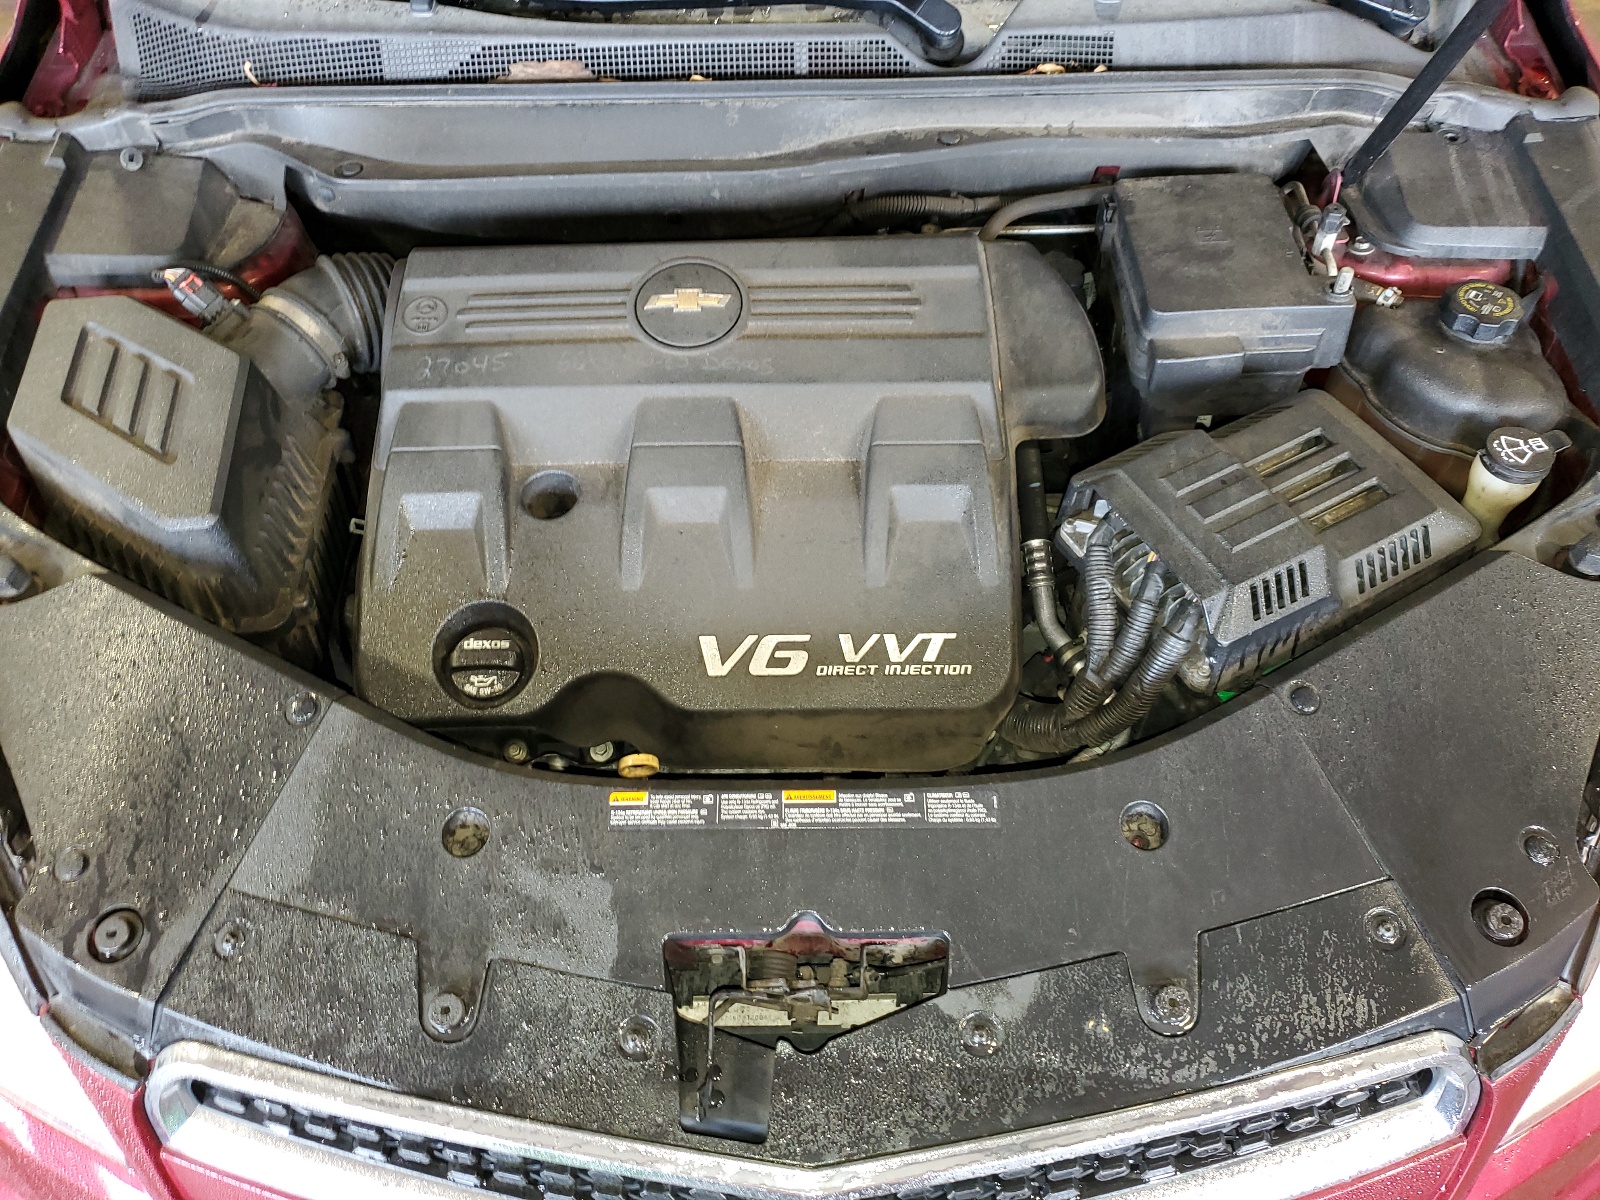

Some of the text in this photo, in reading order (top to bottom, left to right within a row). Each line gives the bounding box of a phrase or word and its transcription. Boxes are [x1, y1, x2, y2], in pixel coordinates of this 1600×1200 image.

[463, 638, 512, 650] dexos
[699, 633, 957, 677] V6 VVT
[816, 664, 973, 676] DIRECT INJECTION
